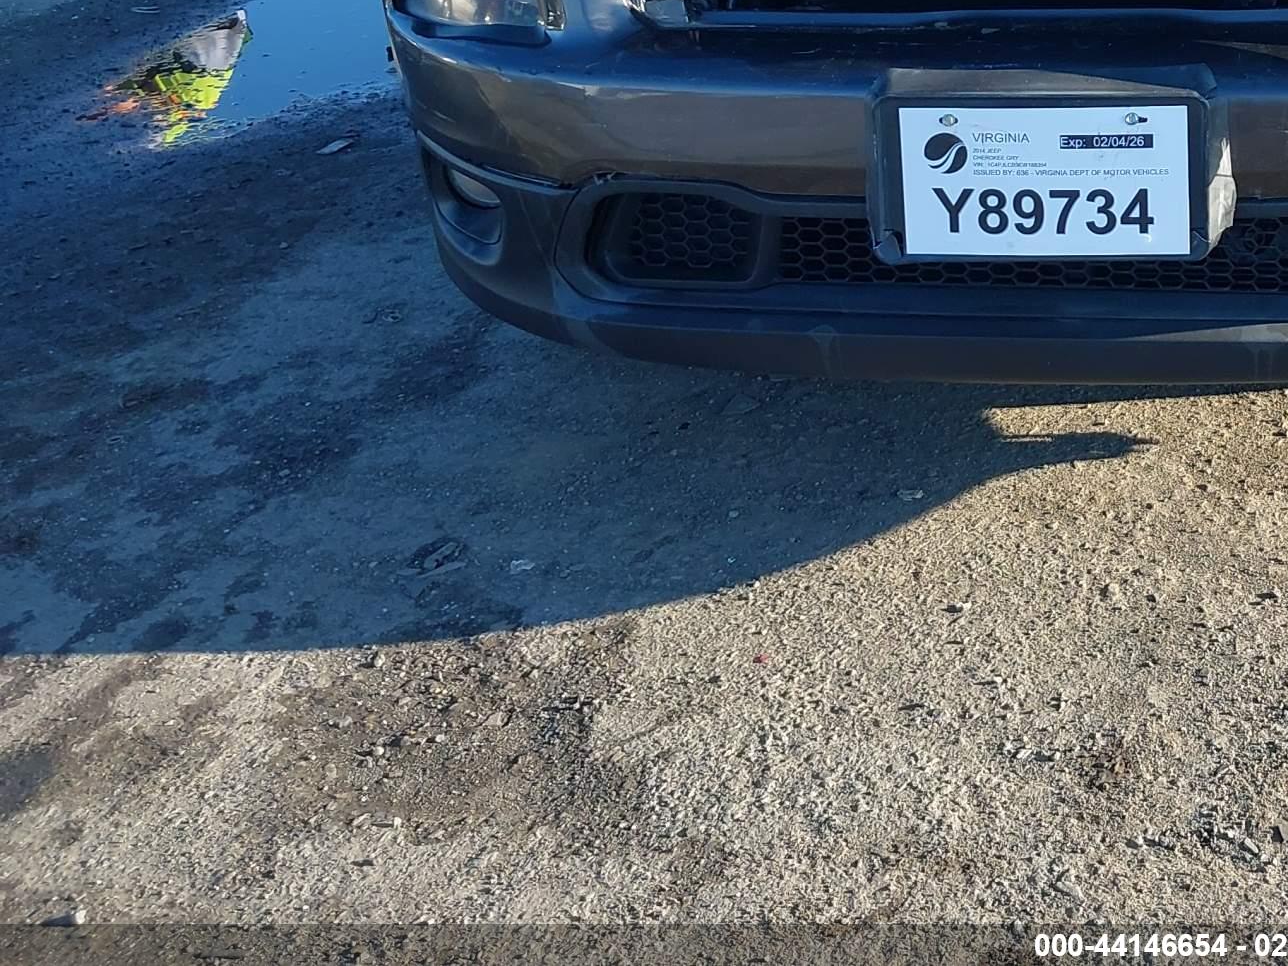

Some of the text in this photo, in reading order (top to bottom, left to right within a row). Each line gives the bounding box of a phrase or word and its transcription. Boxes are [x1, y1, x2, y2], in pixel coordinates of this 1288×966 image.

[972, 132, 1030, 144] VIRGINIA
[1060, 136, 1145, 149] Exp: 02/04/26
[932, 188, 1154, 235] Y89734
